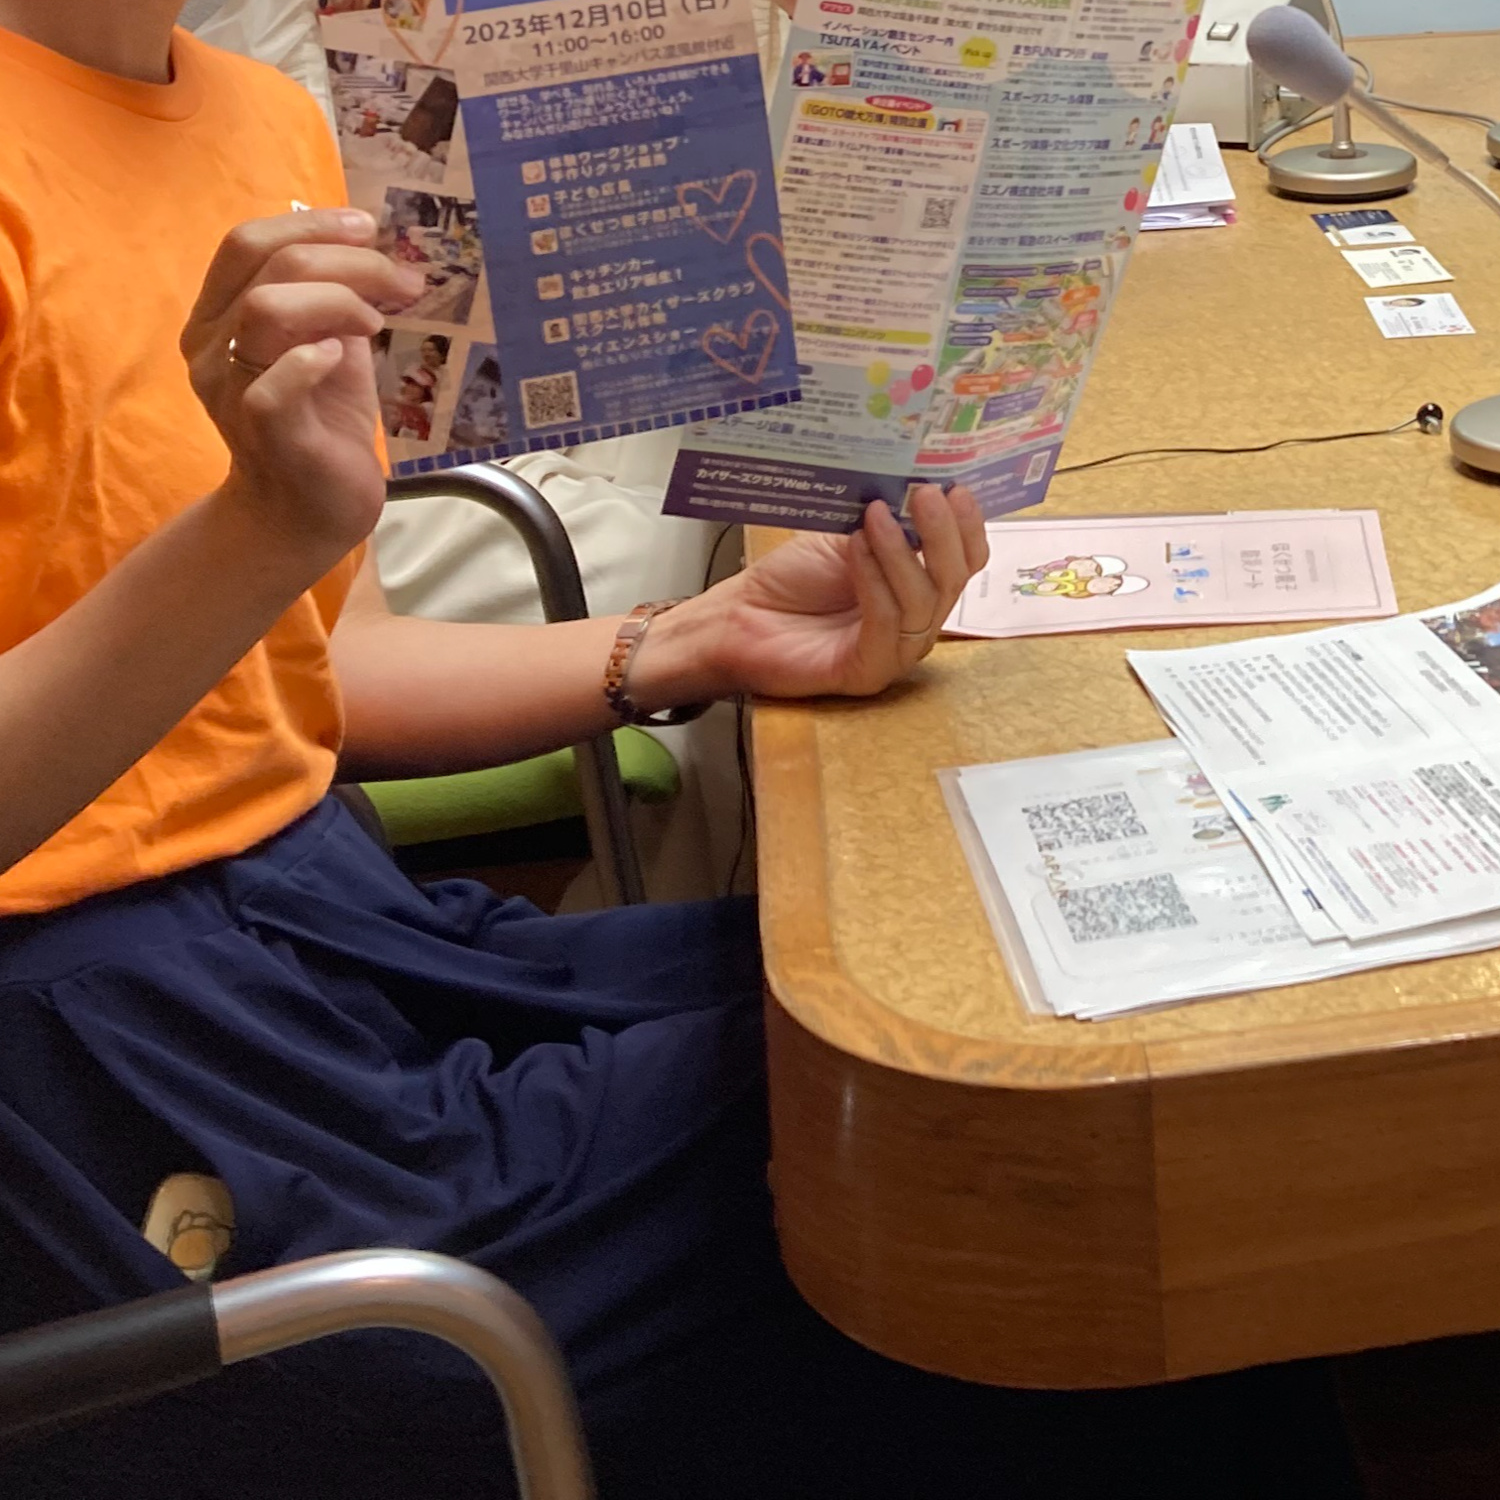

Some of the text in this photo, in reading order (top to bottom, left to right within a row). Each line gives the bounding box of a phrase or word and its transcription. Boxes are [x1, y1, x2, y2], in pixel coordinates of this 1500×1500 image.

[569, 258, 656, 282] キッチンカー
[575, 328, 698, 358] サイエンスショー
